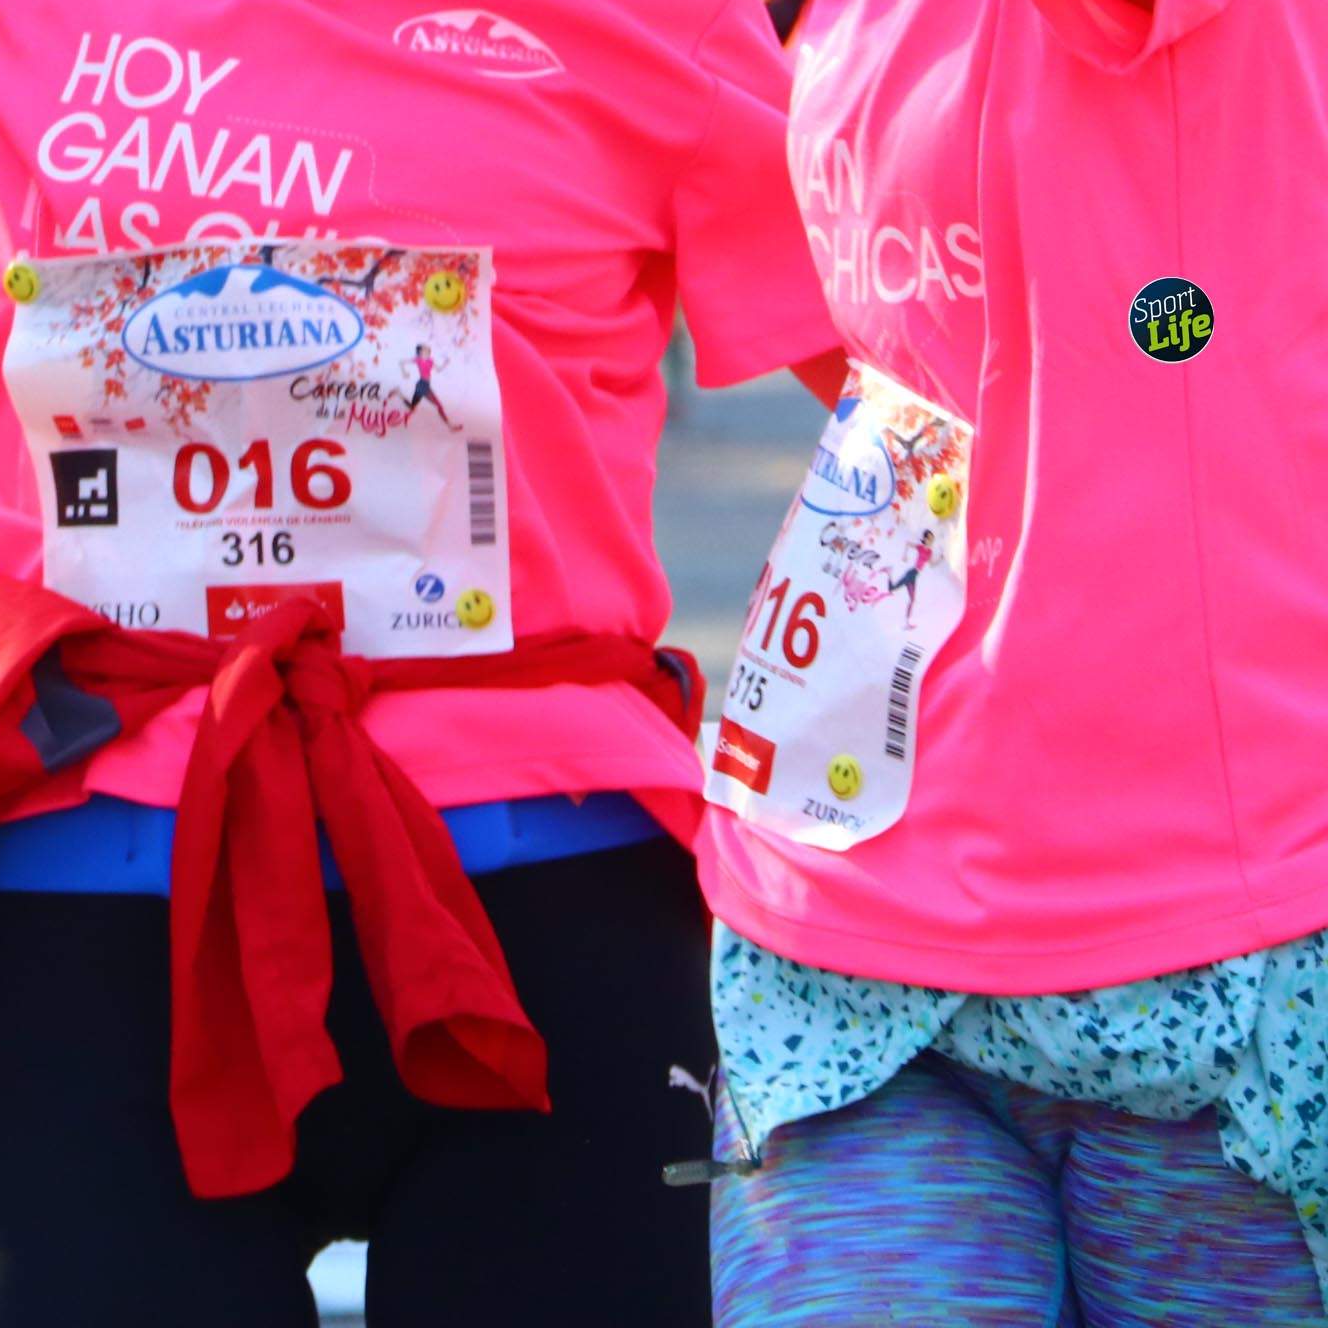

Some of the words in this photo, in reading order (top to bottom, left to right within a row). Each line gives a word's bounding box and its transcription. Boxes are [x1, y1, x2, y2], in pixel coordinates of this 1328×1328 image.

[60, 32, 240, 116] HOY
[36, 112, 353, 217] GANAN
[142, 312, 345, 356] ASTURIANA
[289, 376, 381, 401] Carrera
[345, 399, 414, 439] Mujer
[172, 438, 354, 516] 016
[221, 531, 296, 567] 316
[391, 612, 462, 631] ZURIC
